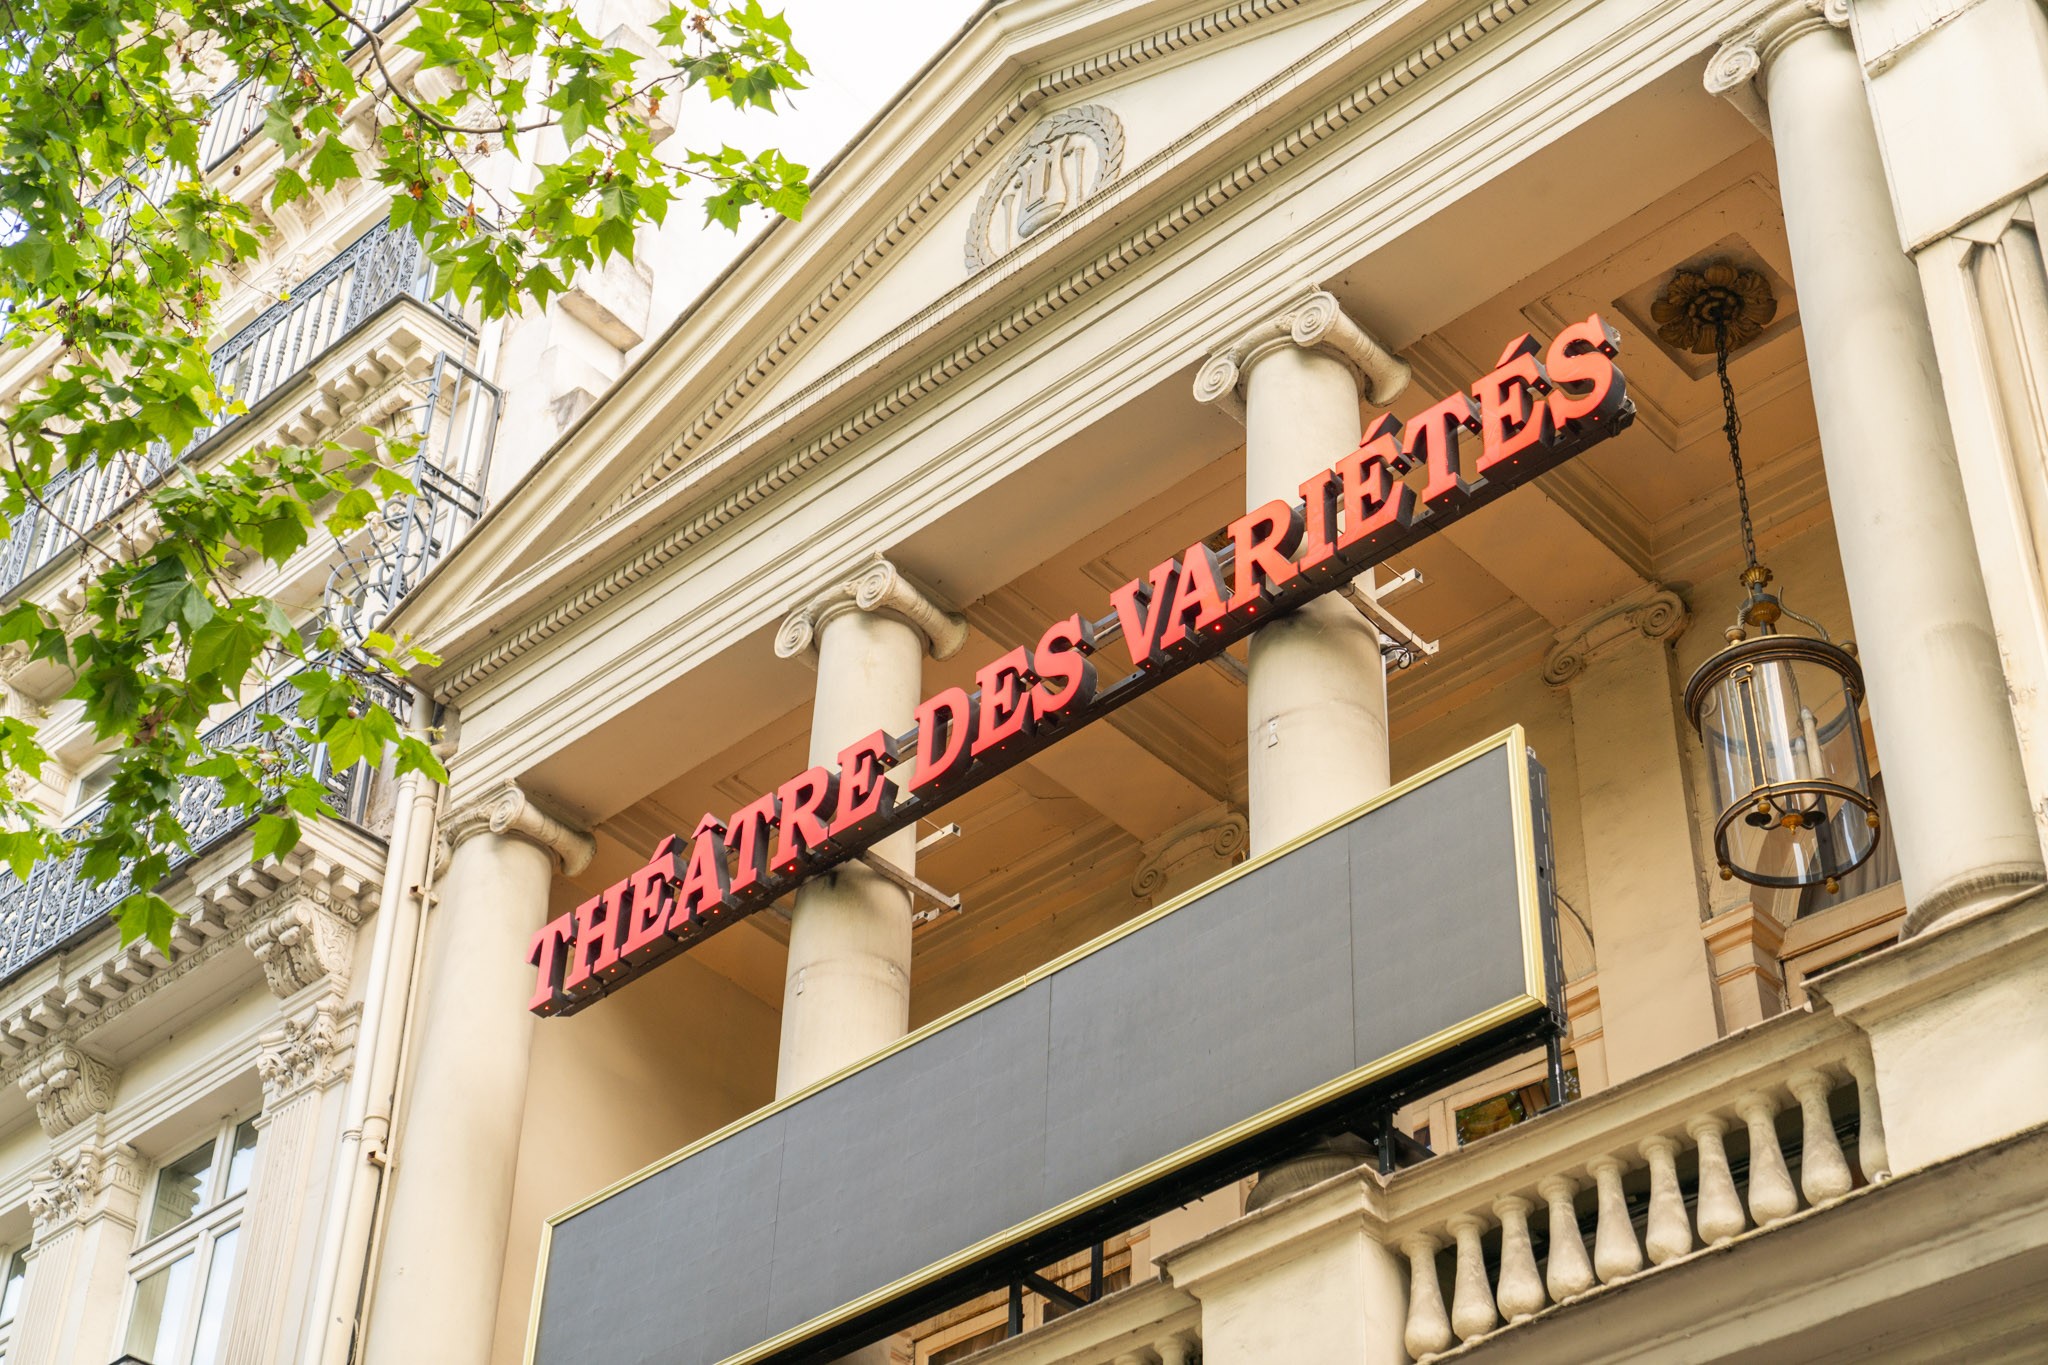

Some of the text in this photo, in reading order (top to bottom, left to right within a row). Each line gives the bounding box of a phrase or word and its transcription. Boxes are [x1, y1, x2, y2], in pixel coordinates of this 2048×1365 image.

[527, 311, 1616, 1013] THÉÂTRE DES VARIÉTÉS
